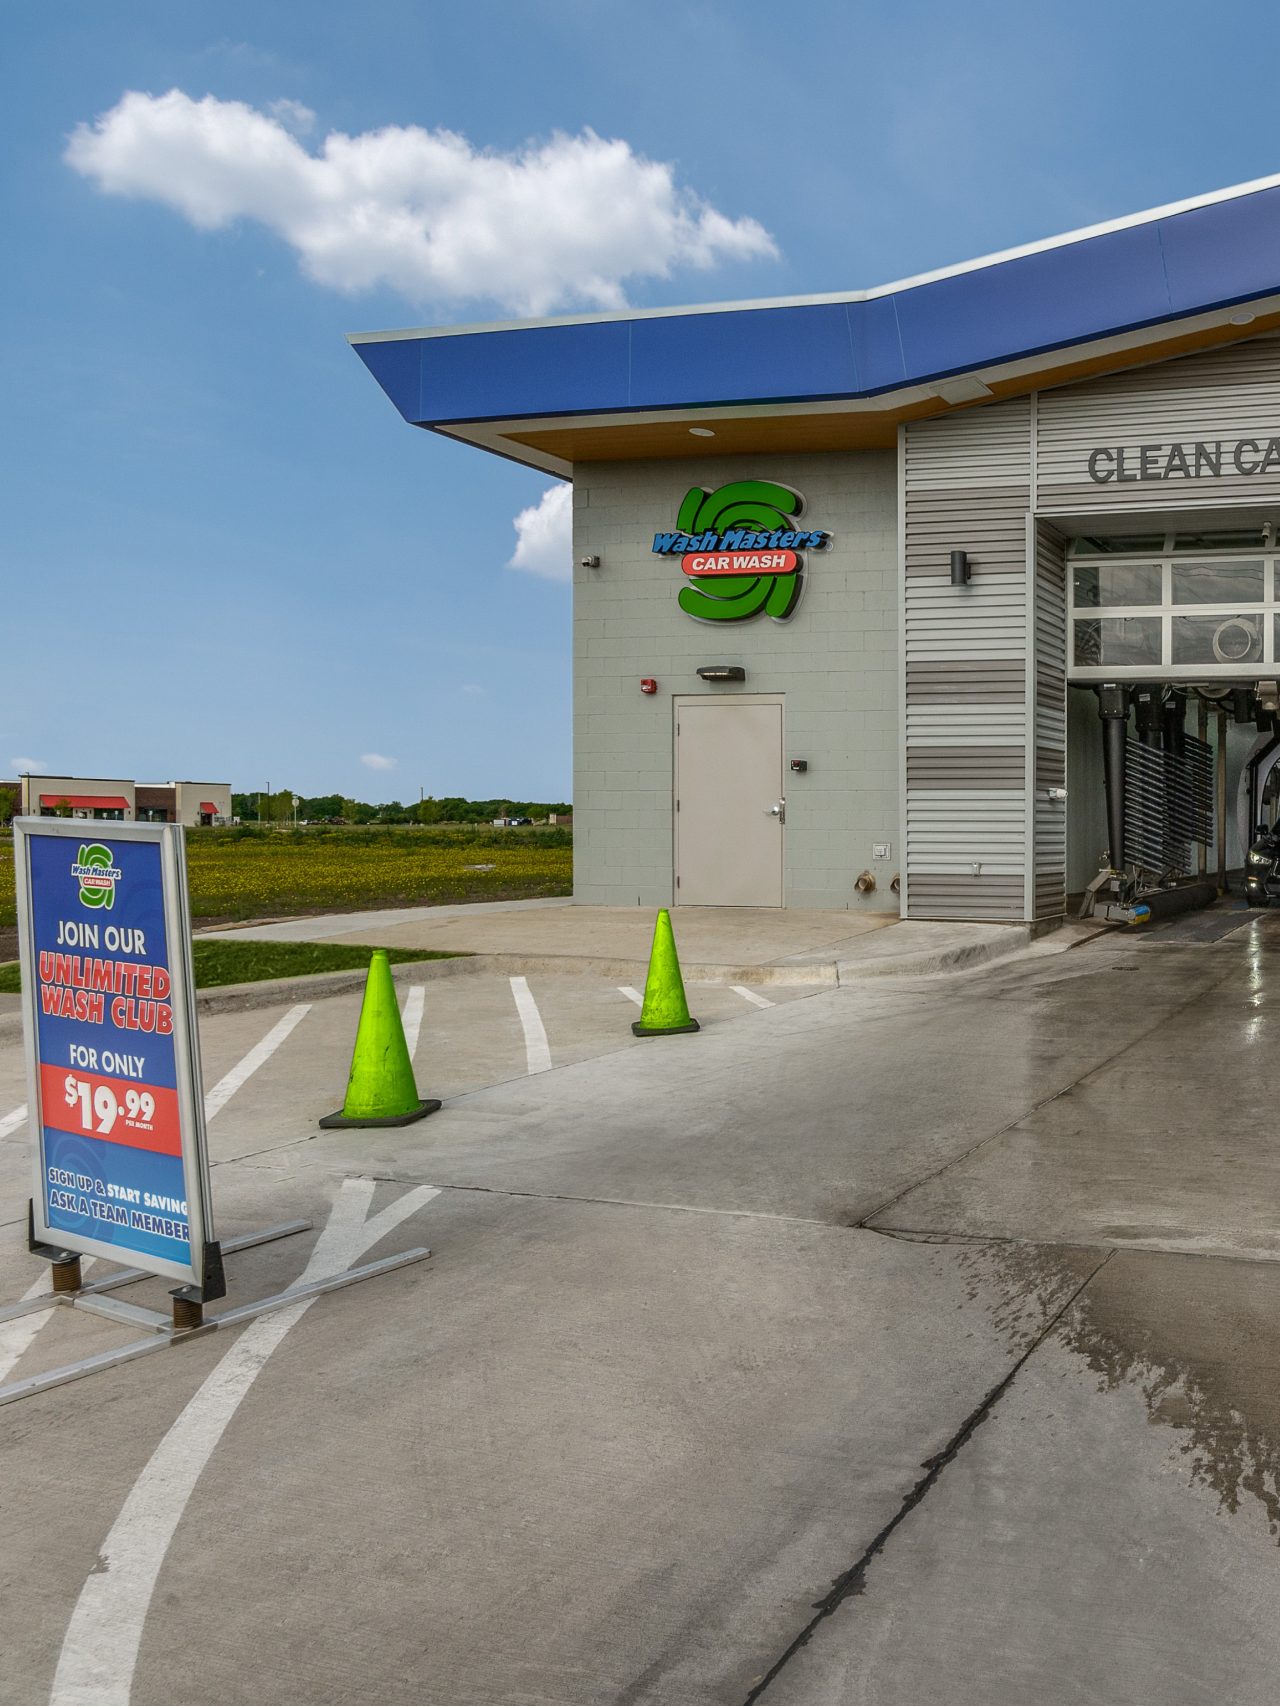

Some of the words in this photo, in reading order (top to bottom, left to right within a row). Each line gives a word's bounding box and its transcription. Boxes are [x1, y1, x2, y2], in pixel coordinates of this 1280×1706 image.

[1088, 441, 1222, 484] CLEAN
[651, 530, 719, 554] Wash
[719, 529, 827, 551] Masters
[692, 557, 730, 571] CAR
[732, 554, 786, 570] WASH
[71, 863, 91, 877] Wash
[91, 865, 122, 880] Masters
[84, 877, 96, 885] CAR
[95, 879, 111, 887] WASH
[57, 920, 99, 949] JOIN
[104, 926, 147, 955] OUR
[39, 950, 171, 1001] UNLIMITED
[40, 984, 104, 1025] WASH
[111, 996, 174, 1035] CLUB
[69, 1043, 99, 1070] FOR
[101, 1050, 145, 1078] ONLY
[125, 1119, 135, 1127] PER
[135, 1121, 154, 1131] MONTH
[48, 1166, 76, 1188] SIGN
[77, 1173, 94, 1193] UP
[94, 1179, 107, 1197] &
[106, 1183, 141, 1205] START
[50, 1188, 77, 1213] ASK
[78, 1196, 90, 1217] A
[90, 1199, 129, 1227] TEAM
[131, 1210, 190, 1243] MEMBER
